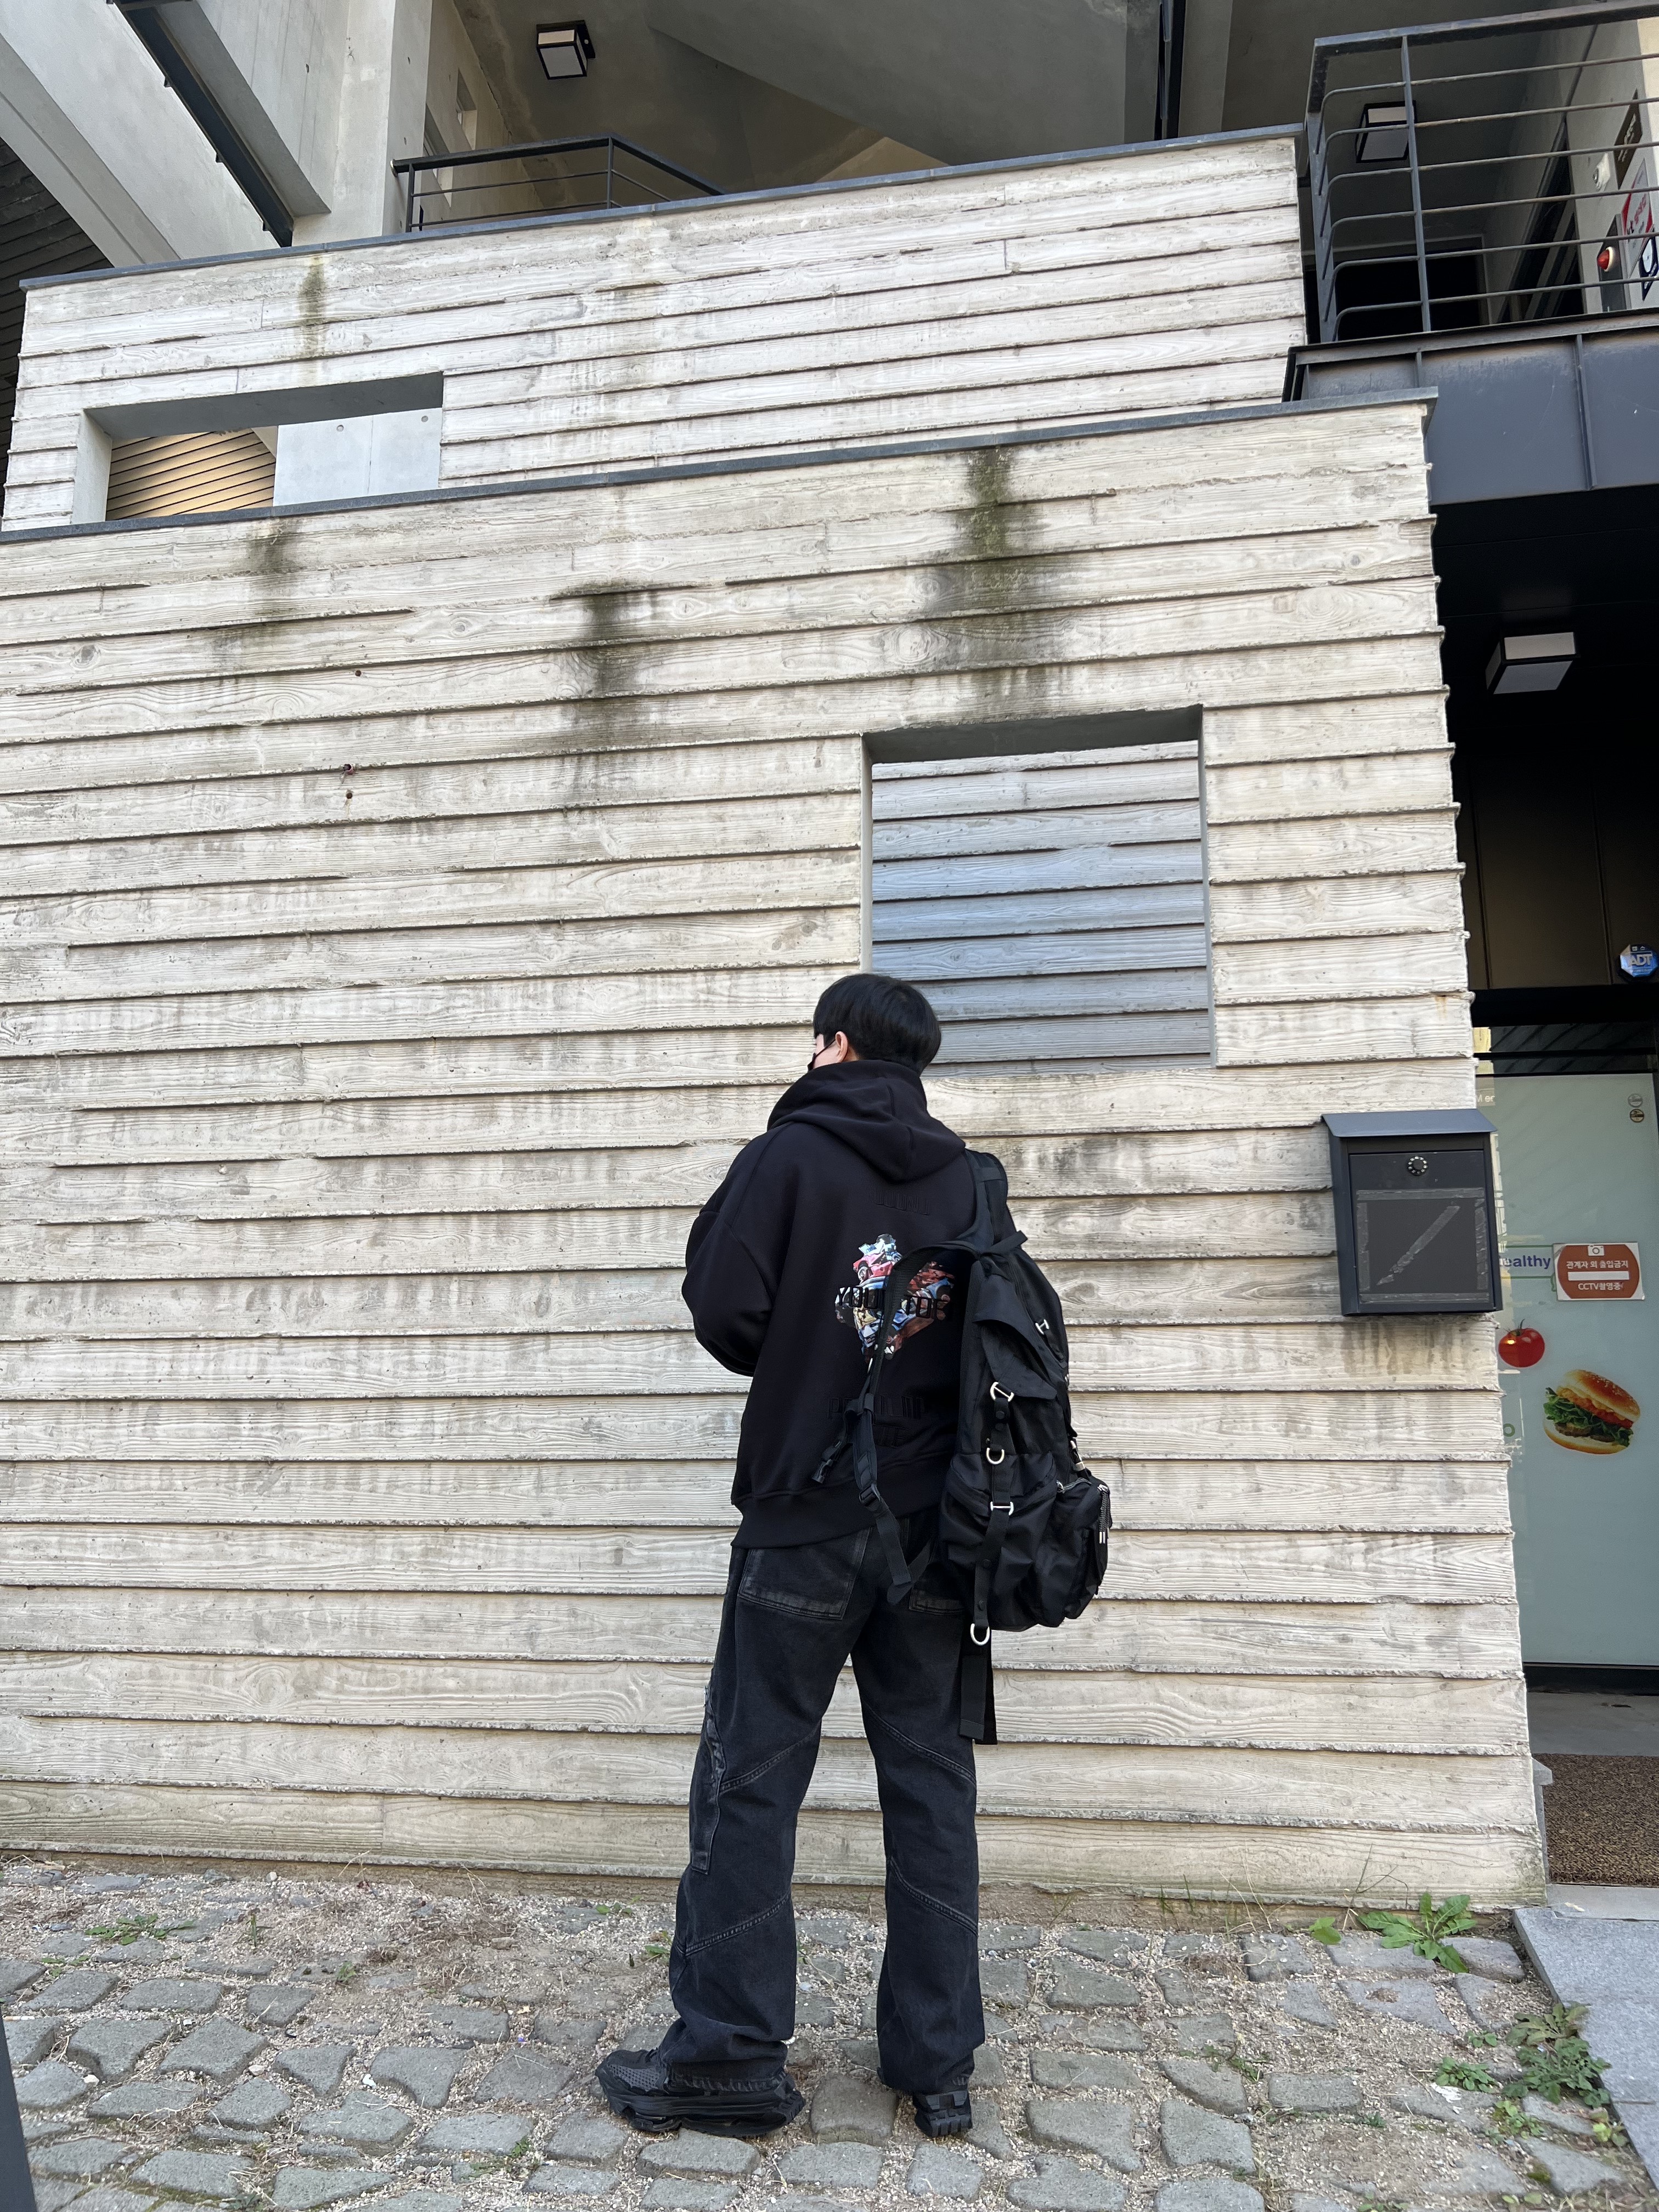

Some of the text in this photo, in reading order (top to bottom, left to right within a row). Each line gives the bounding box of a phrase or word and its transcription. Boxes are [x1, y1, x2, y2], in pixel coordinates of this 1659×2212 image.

[1630, 953, 1652, 966] ADT
[1499, 1255, 1551, 1269] ealthy
[1566, 1260, 1628, 1269] 관계자 외 출입금지
